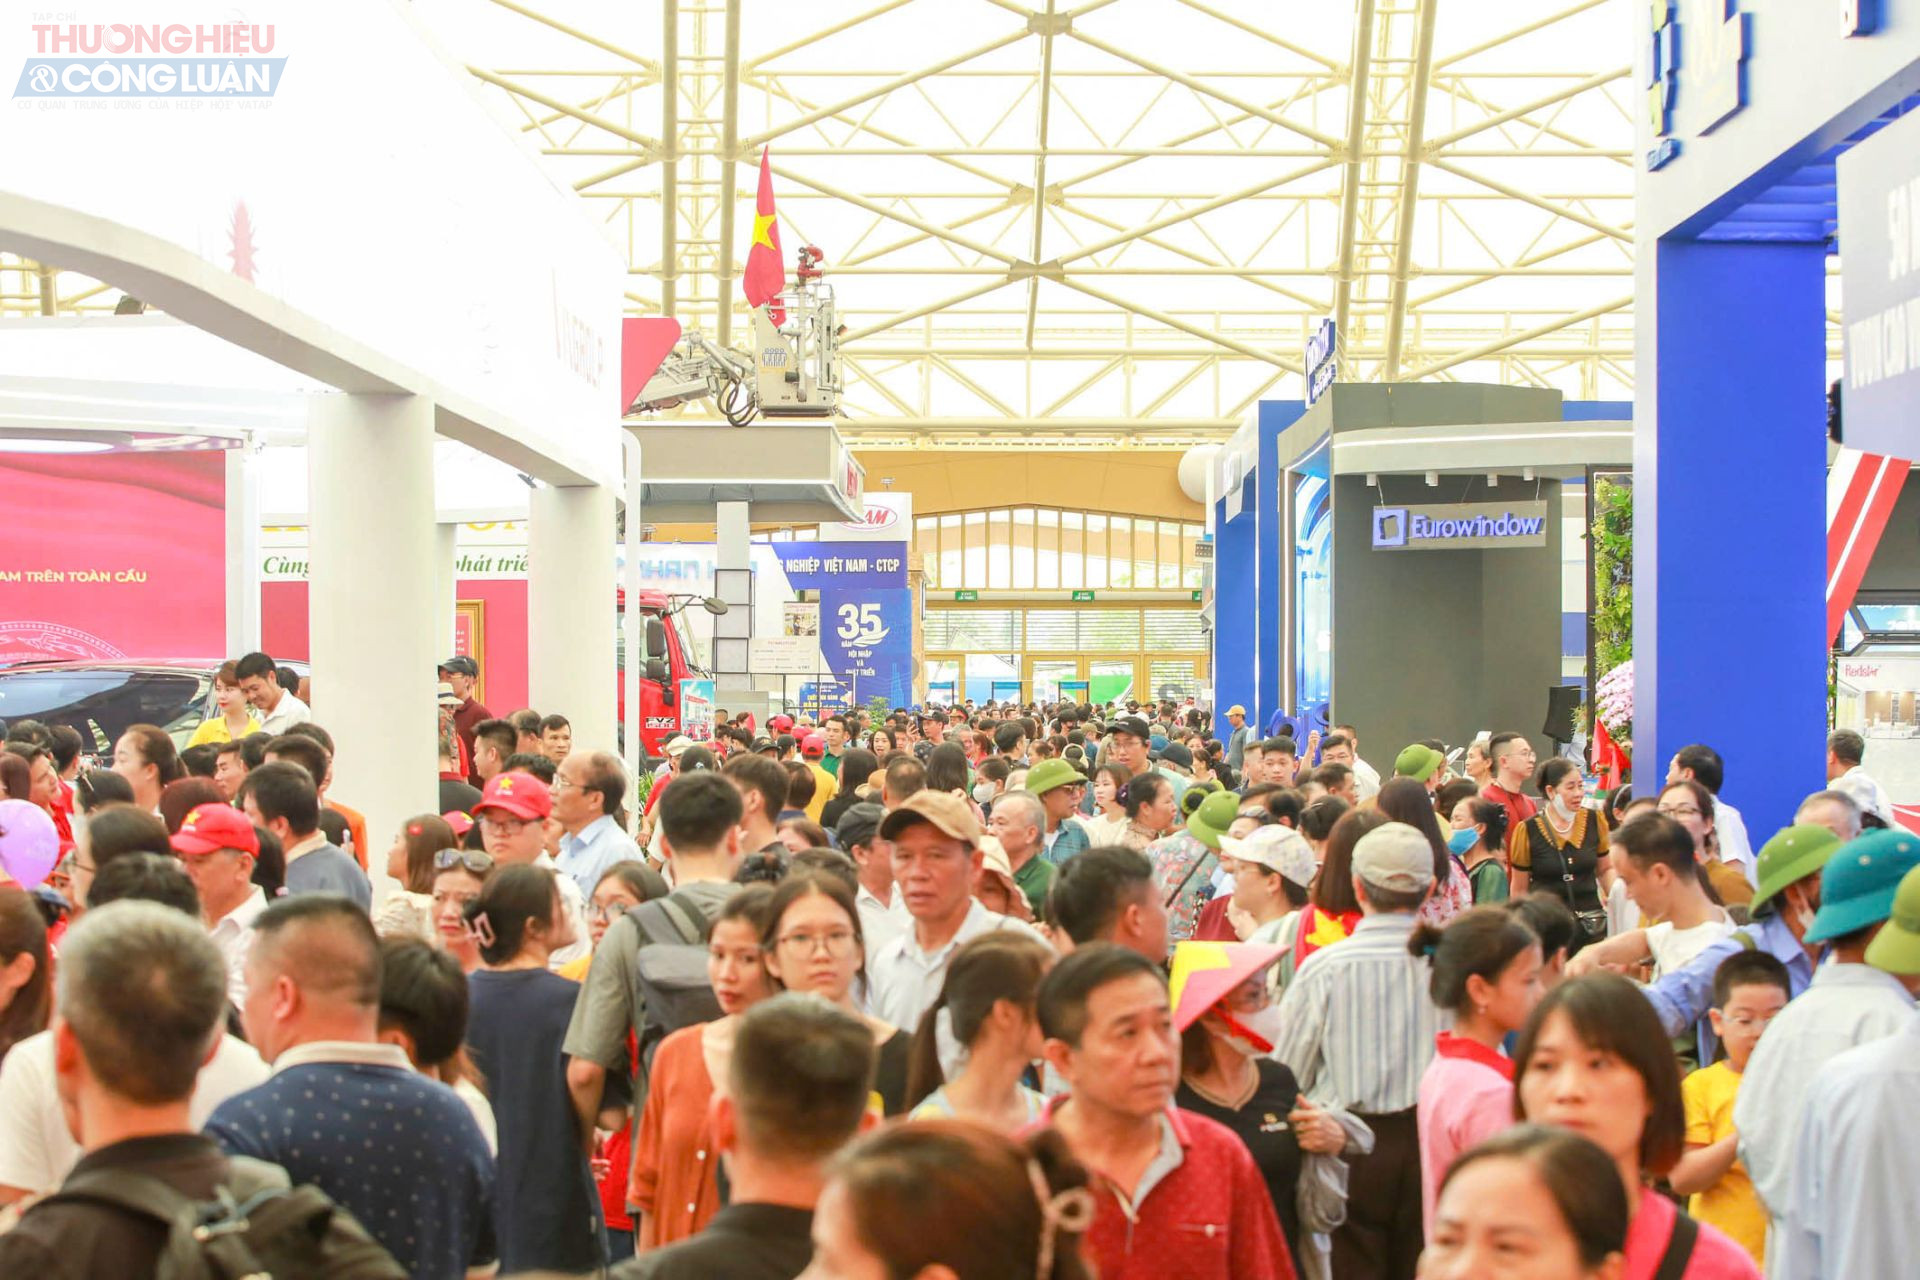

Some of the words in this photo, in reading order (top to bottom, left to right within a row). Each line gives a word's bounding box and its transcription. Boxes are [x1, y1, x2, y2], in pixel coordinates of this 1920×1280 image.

[1411, 512, 1544, 538] Eurowindow
[25, 569, 65, 583] TRÊN
[67, 569, 111, 583] TOÀN
[786, 556, 821, 575] NGHIỆP
[823, 556, 844, 575] VIỆT
[845, 559, 868, 573] NAM
[876, 559, 900, 573] CTCP
[837, 603, 882, 639] 35
